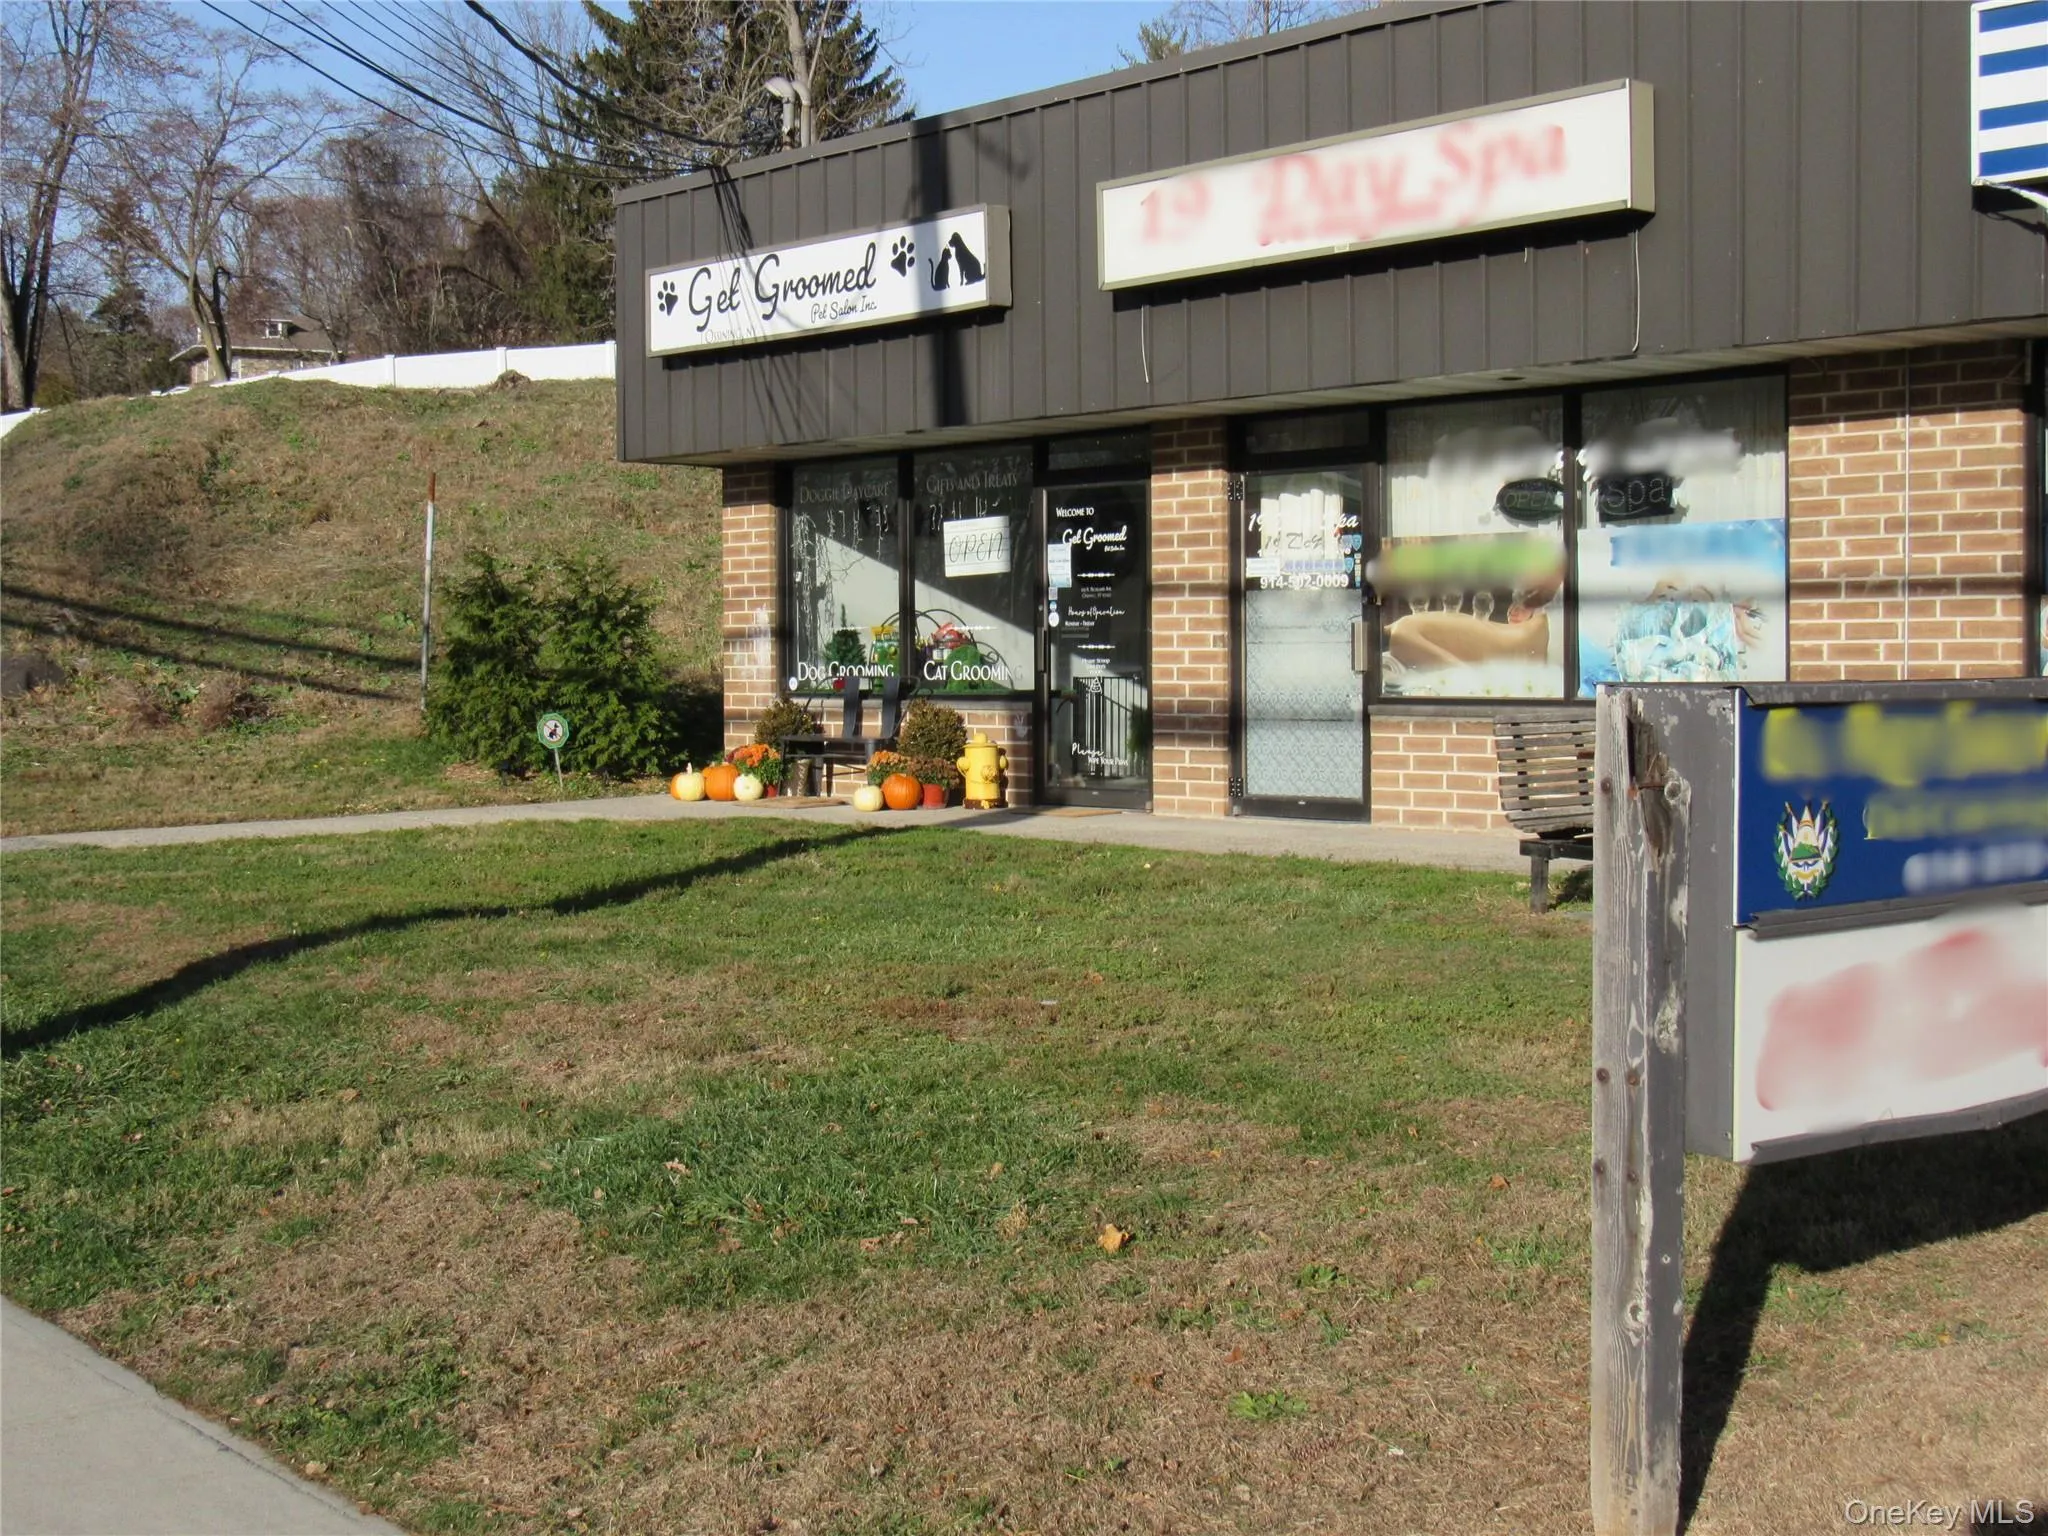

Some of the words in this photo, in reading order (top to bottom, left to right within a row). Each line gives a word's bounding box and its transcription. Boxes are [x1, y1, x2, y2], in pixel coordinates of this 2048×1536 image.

[688, 266, 741, 332] Get
[754, 243, 877, 320] Groomed
[811, 303, 828, 324] Pet
[829, 298, 858, 320] Salon
[860, 295, 878, 312] Inc.
[949, 532, 1003, 564] OPEN
[1062, 528, 1081, 547] Get
[1083, 524, 1127, 550] Groomed
[798, 661, 825, 681] DOG
[828, 660, 895, 681] GROOMING
[924, 660, 947, 681] CAT
